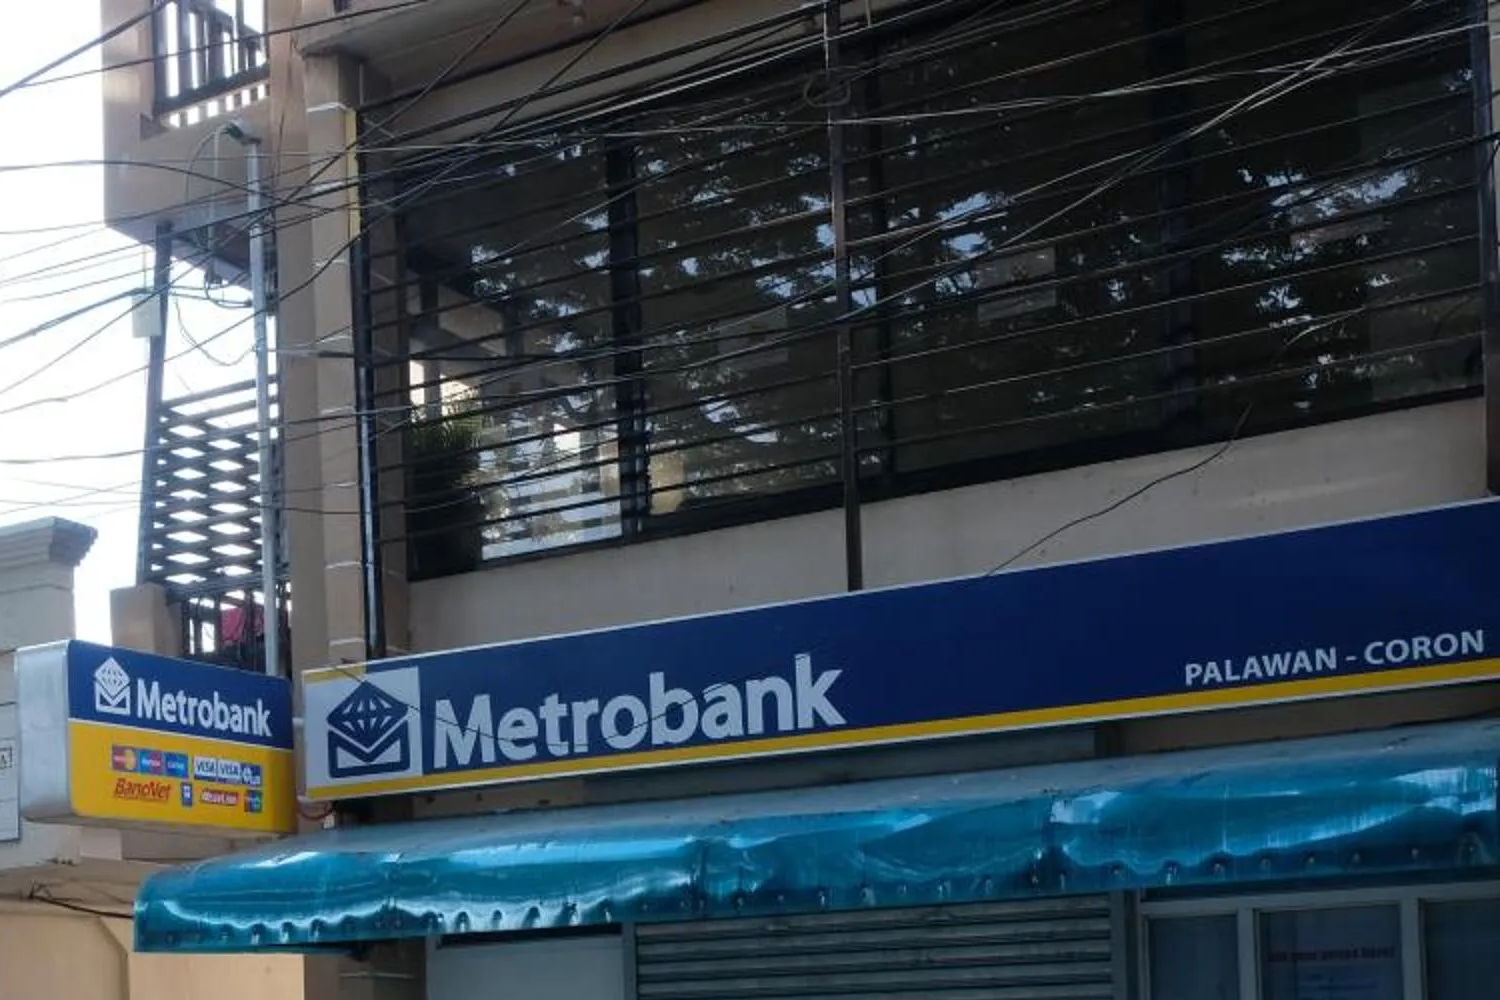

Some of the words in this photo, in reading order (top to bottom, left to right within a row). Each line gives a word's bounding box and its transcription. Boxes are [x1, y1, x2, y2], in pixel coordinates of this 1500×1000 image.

[1184, 647, 1338, 686] PALAWAN
[1363, 630, 1485, 665] CORON
[136, 678, 273, 737] Metrobank
[433, 653, 847, 768] Metrobank
[195, 760, 216, 773] VISA
[220, 763, 240, 776] VISA
